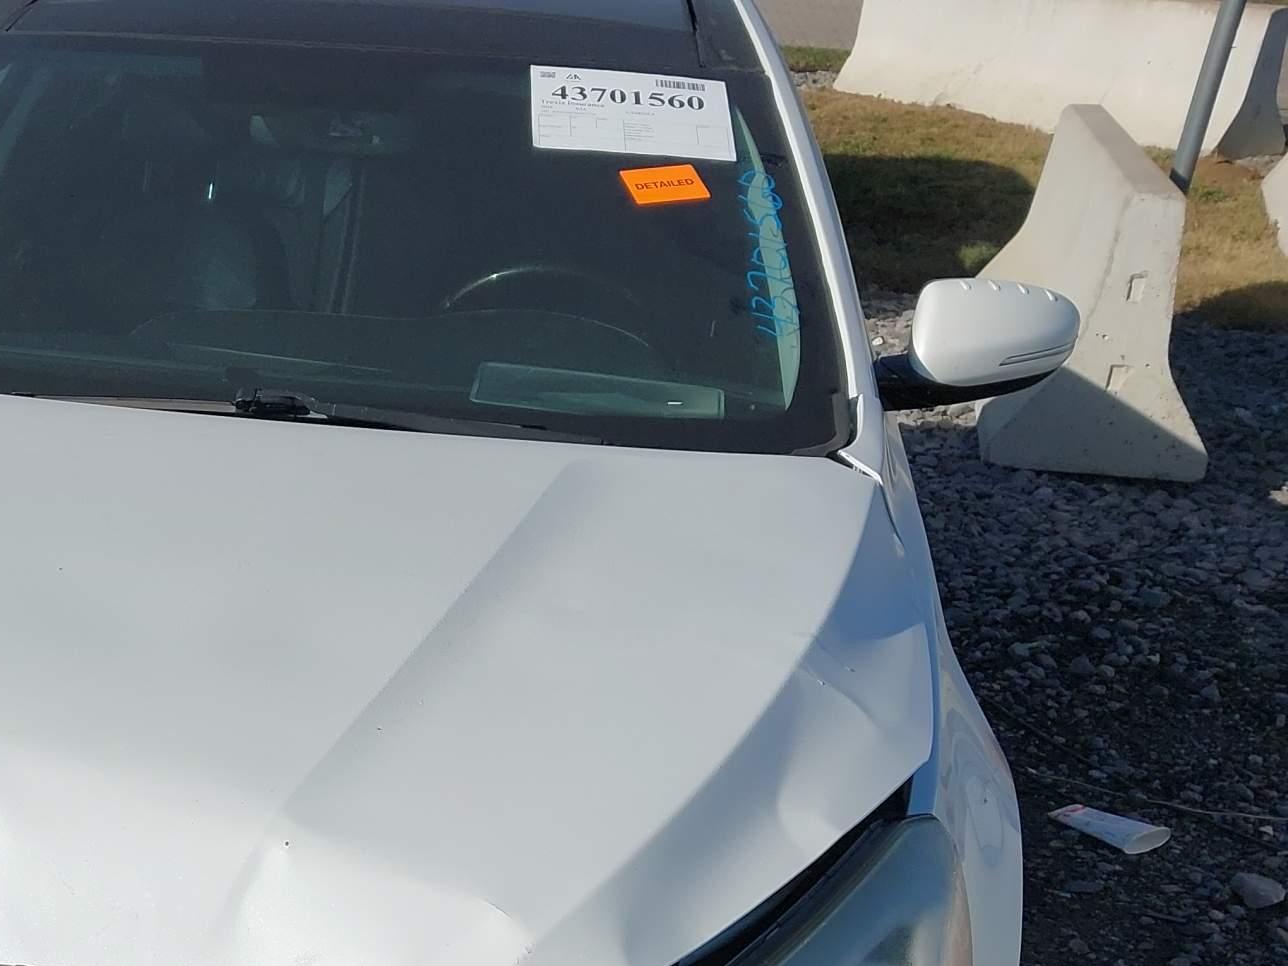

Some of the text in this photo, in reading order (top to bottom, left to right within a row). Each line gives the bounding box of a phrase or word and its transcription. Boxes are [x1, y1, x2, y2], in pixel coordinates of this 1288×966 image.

[551, 84, 705, 111] 43701560
[634, 177, 695, 191] DETAILED
[737, 169, 800, 337] 43701560
